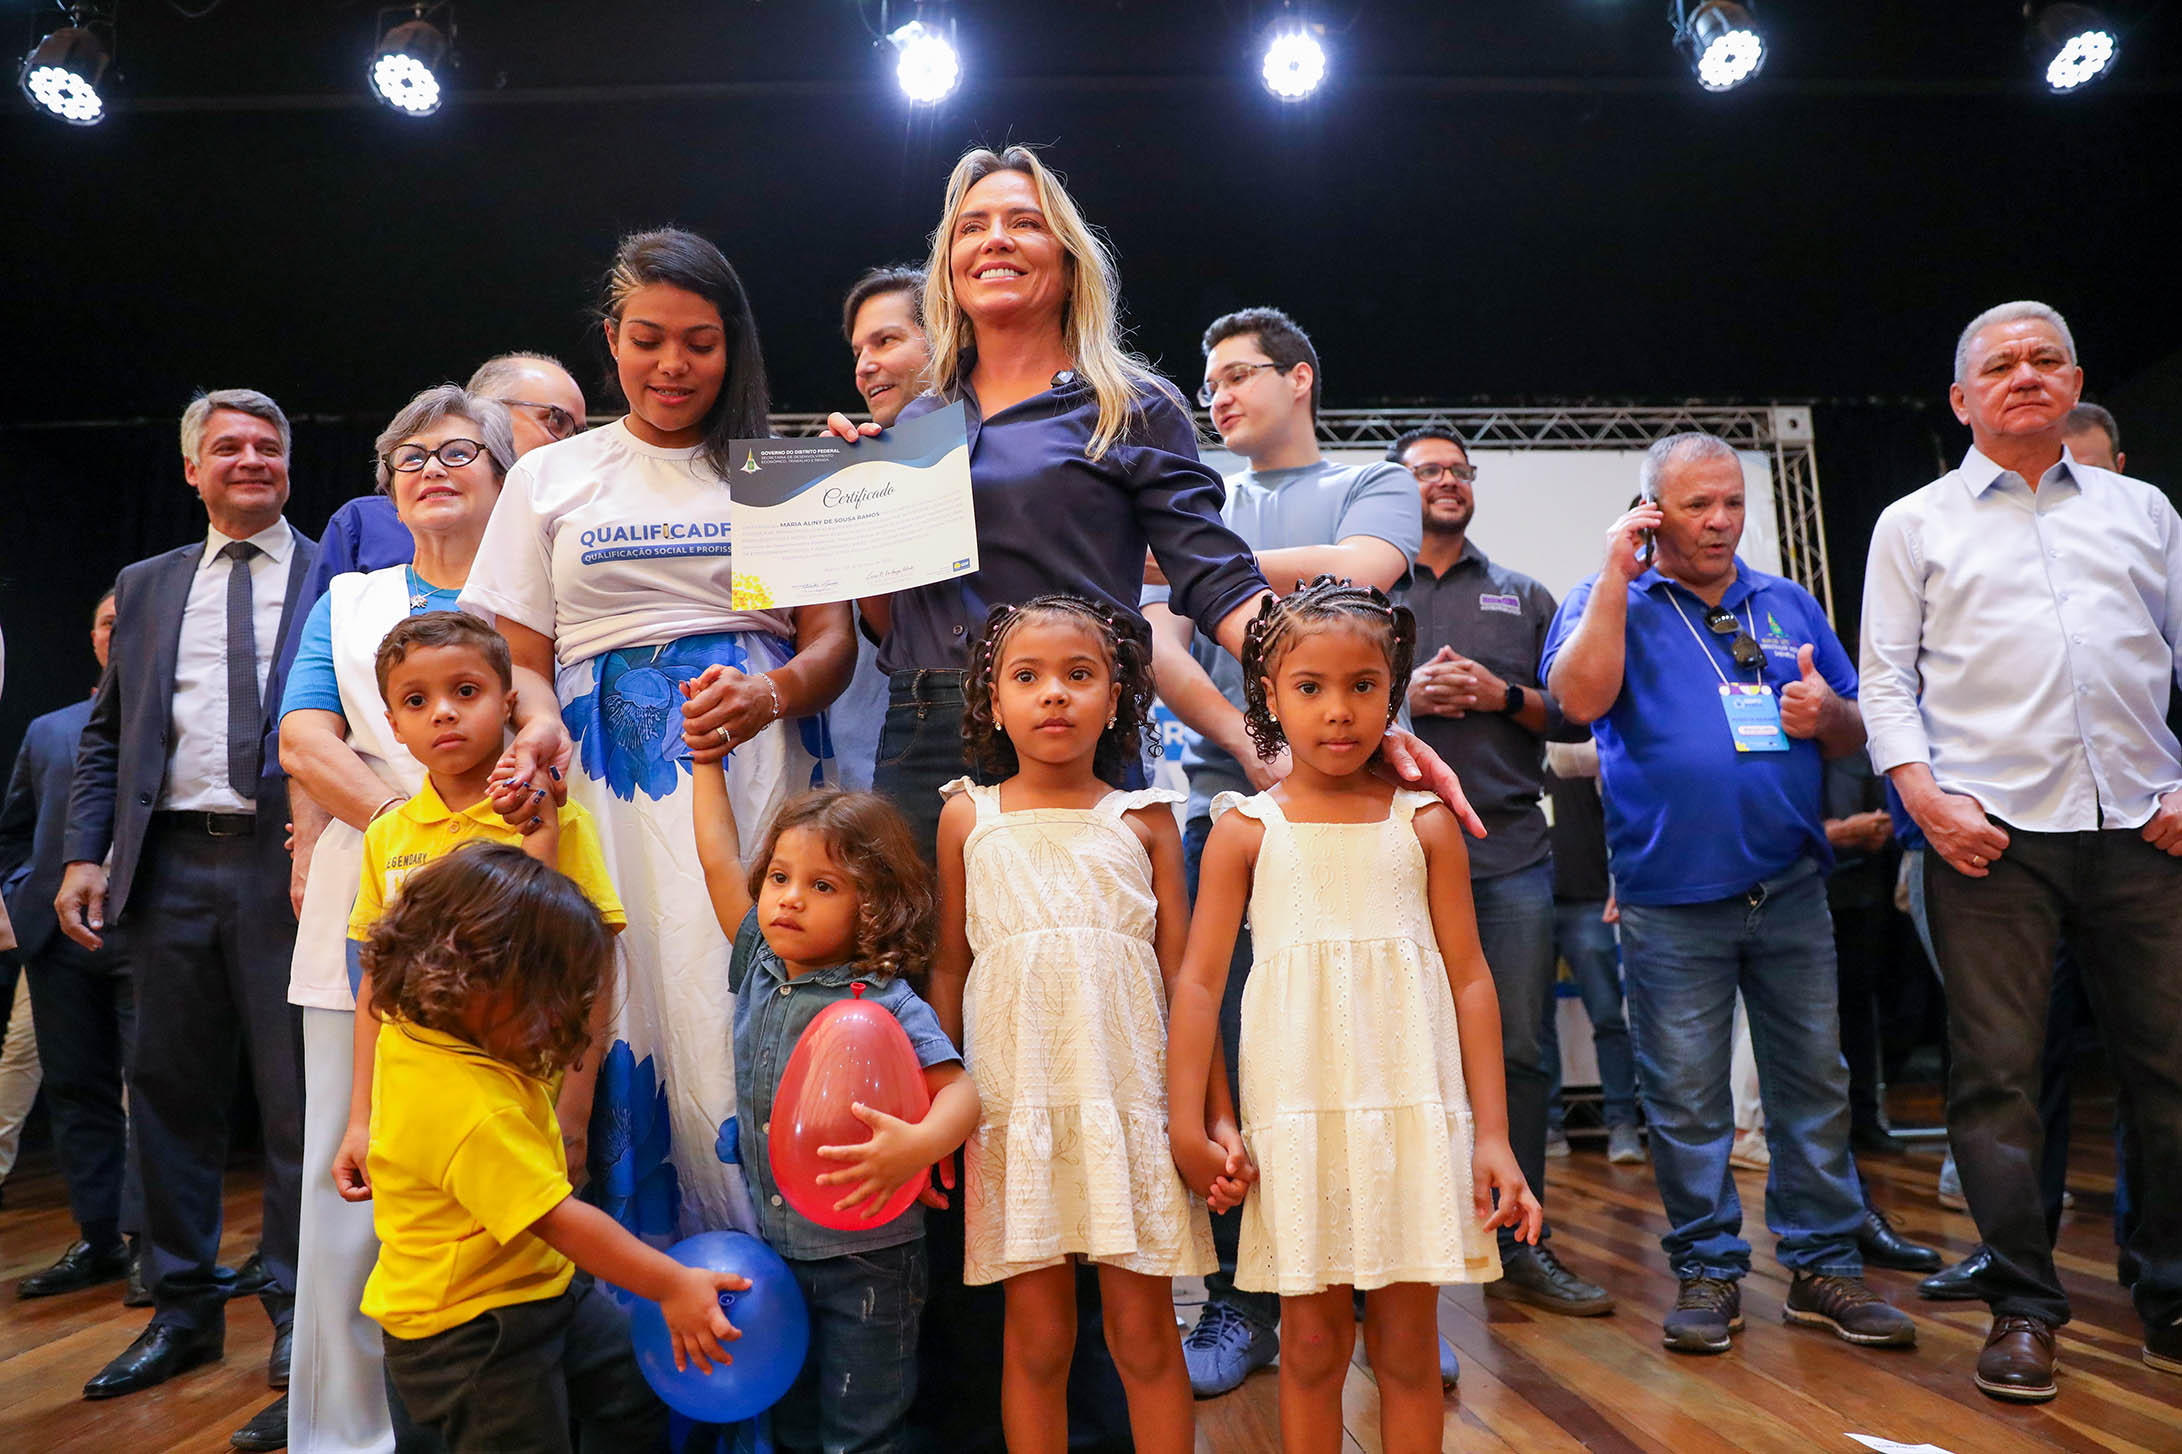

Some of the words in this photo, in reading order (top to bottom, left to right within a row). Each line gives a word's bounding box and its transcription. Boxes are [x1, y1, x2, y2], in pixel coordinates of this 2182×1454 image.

[823, 481, 894, 509] Certificado
[857, 511, 880, 520] RAMOS
[580, 522, 732, 547] QUALIFICADF
[584, 547, 652, 562] QUALIFICAÇÃO
[654, 546, 687, 556] SOCIAL
